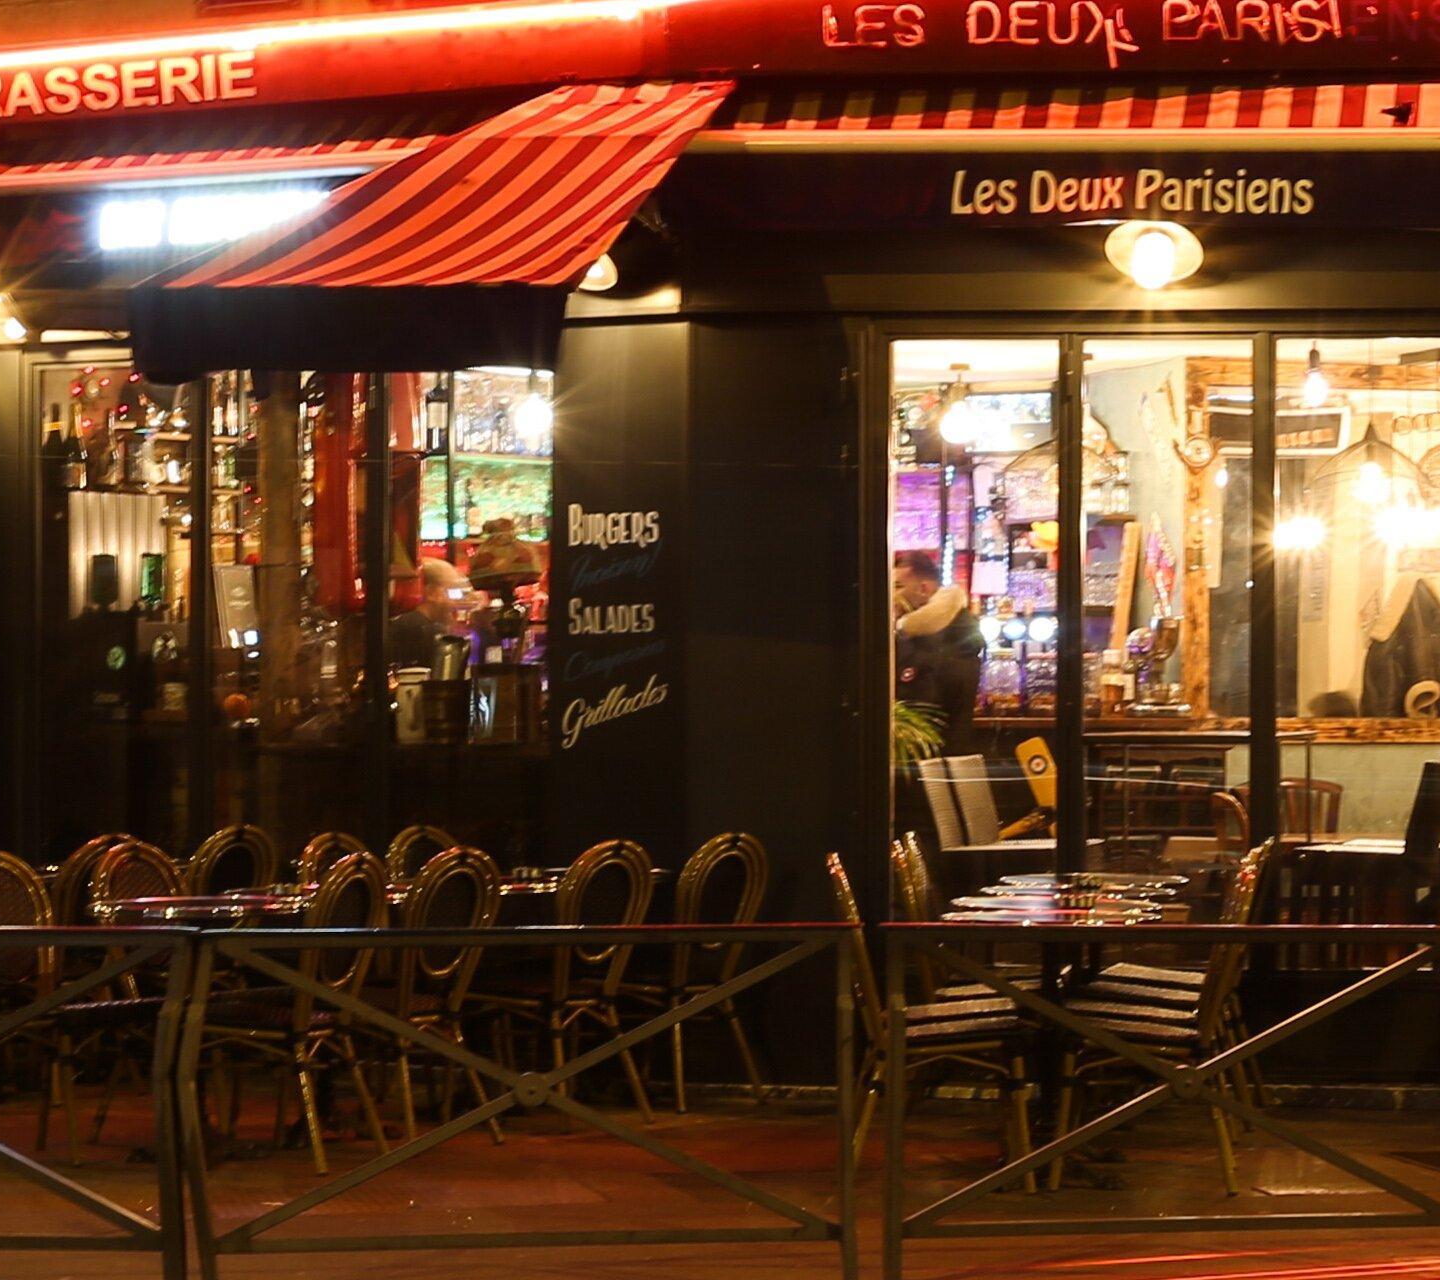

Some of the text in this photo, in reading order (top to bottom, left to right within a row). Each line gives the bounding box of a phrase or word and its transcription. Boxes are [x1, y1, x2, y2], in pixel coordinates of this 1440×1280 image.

[822, 2, 927, 47] LES
[965, 0, 1139, 69] DEUX
[951, 166, 1315, 216] Les Deux Parisiens
[567, 503, 661, 550] BURGERS
[567, 597, 656, 636] SALADES
[561, 673, 670, 750] Grillades
